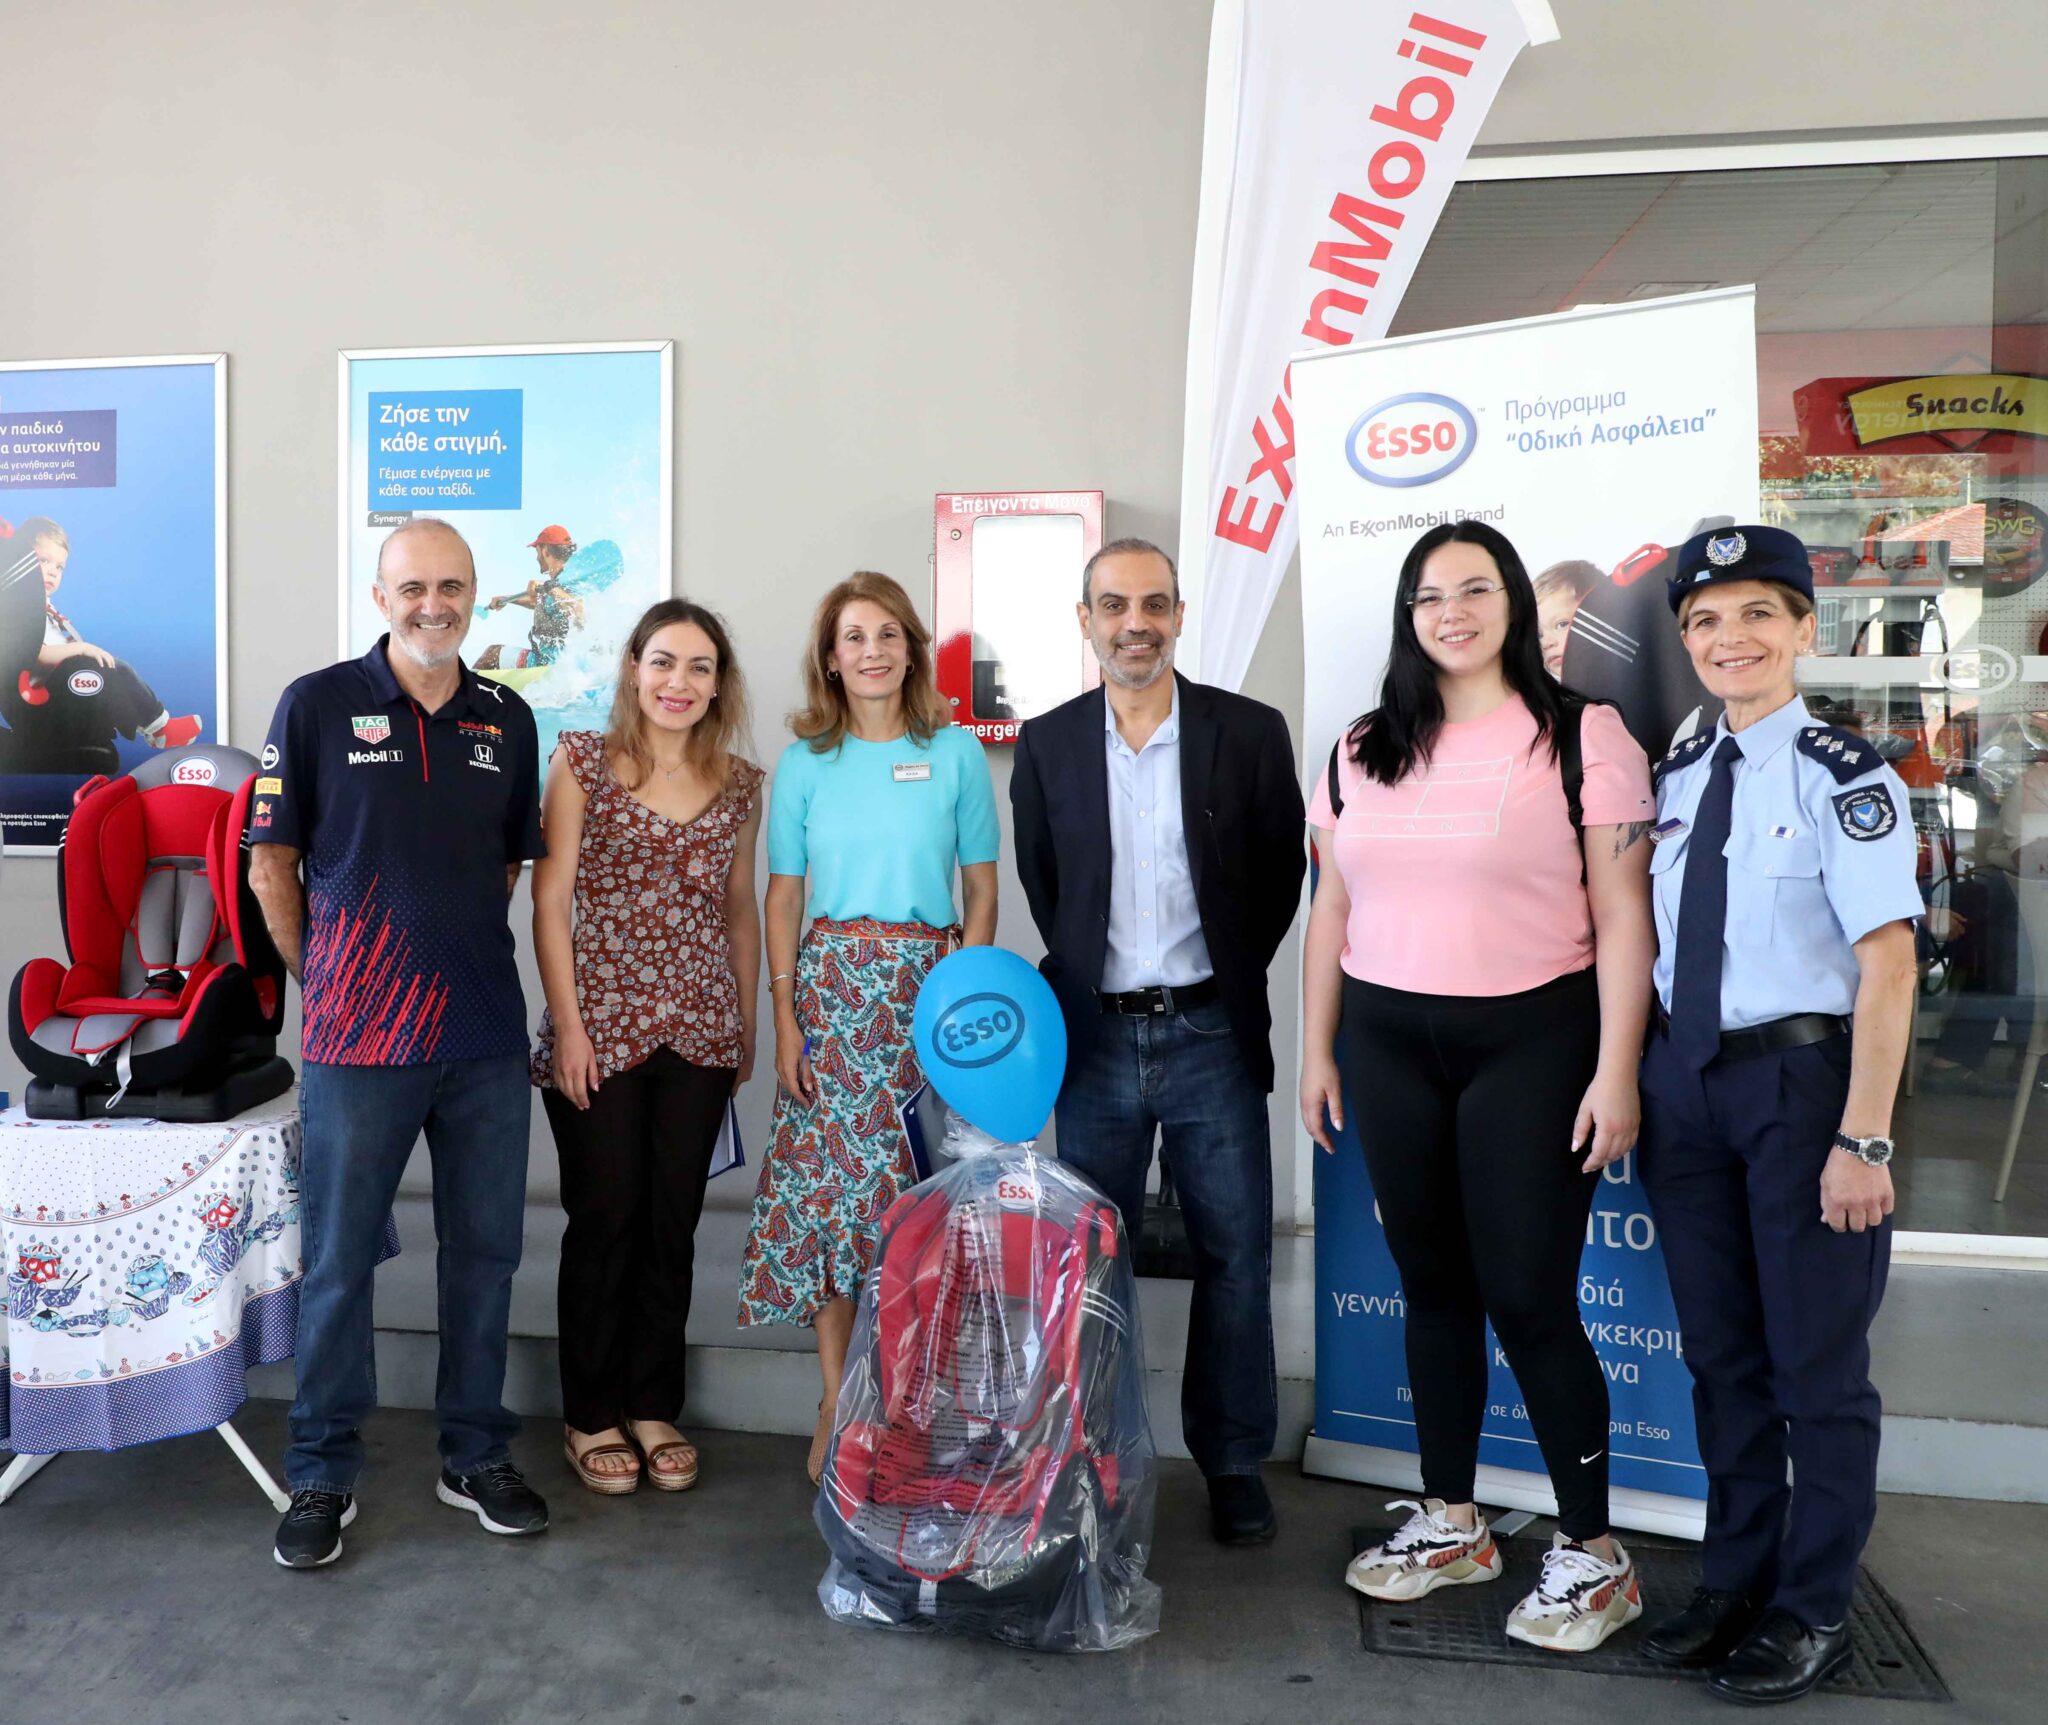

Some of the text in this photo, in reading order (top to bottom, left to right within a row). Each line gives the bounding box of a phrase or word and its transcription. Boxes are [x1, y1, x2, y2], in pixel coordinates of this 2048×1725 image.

[1215, 12, 1487, 553] ExnMobil
[1505, 389, 1627, 424] Πρόγραμμα
[1906, 387, 2025, 417] Snacks
[379, 402, 470, 427] Ζήσε την
[11, 420, 64, 435] παιδικό
[13, 438, 101, 455] αυτοκινήτου
[379, 429, 508, 455] κάθε στιγμή.
[11, 459, 60, 471] γεννήθηκαν
[61, 460, 75, 469] μία
[379, 465, 492, 481] Γέμισε ενέργεια με
[10, 472, 31, 482] μέρα
[33, 471, 54, 481] κάθε
[379, 482, 476, 498] κάθε σου ταξίδι.
[373, 514, 408, 526] Synergy
[1322, 504, 1505, 538] An ExxonMobil Brand
[354, 717, 386, 728] TAG
[356, 728, 388, 742] HEUER
[459, 730, 503, 743] RACING
[950, 721, 1023, 741] merge
[348, 751, 388, 765] Mobil
[469, 760, 501, 772] HONDA
[1332, 1290, 1407, 1318] γεννή
[1490, 1404, 1508, 1417] σε
[1512, 1403, 1530, 1421] όλ
[1637, 1421, 1671, 1440] Esso
